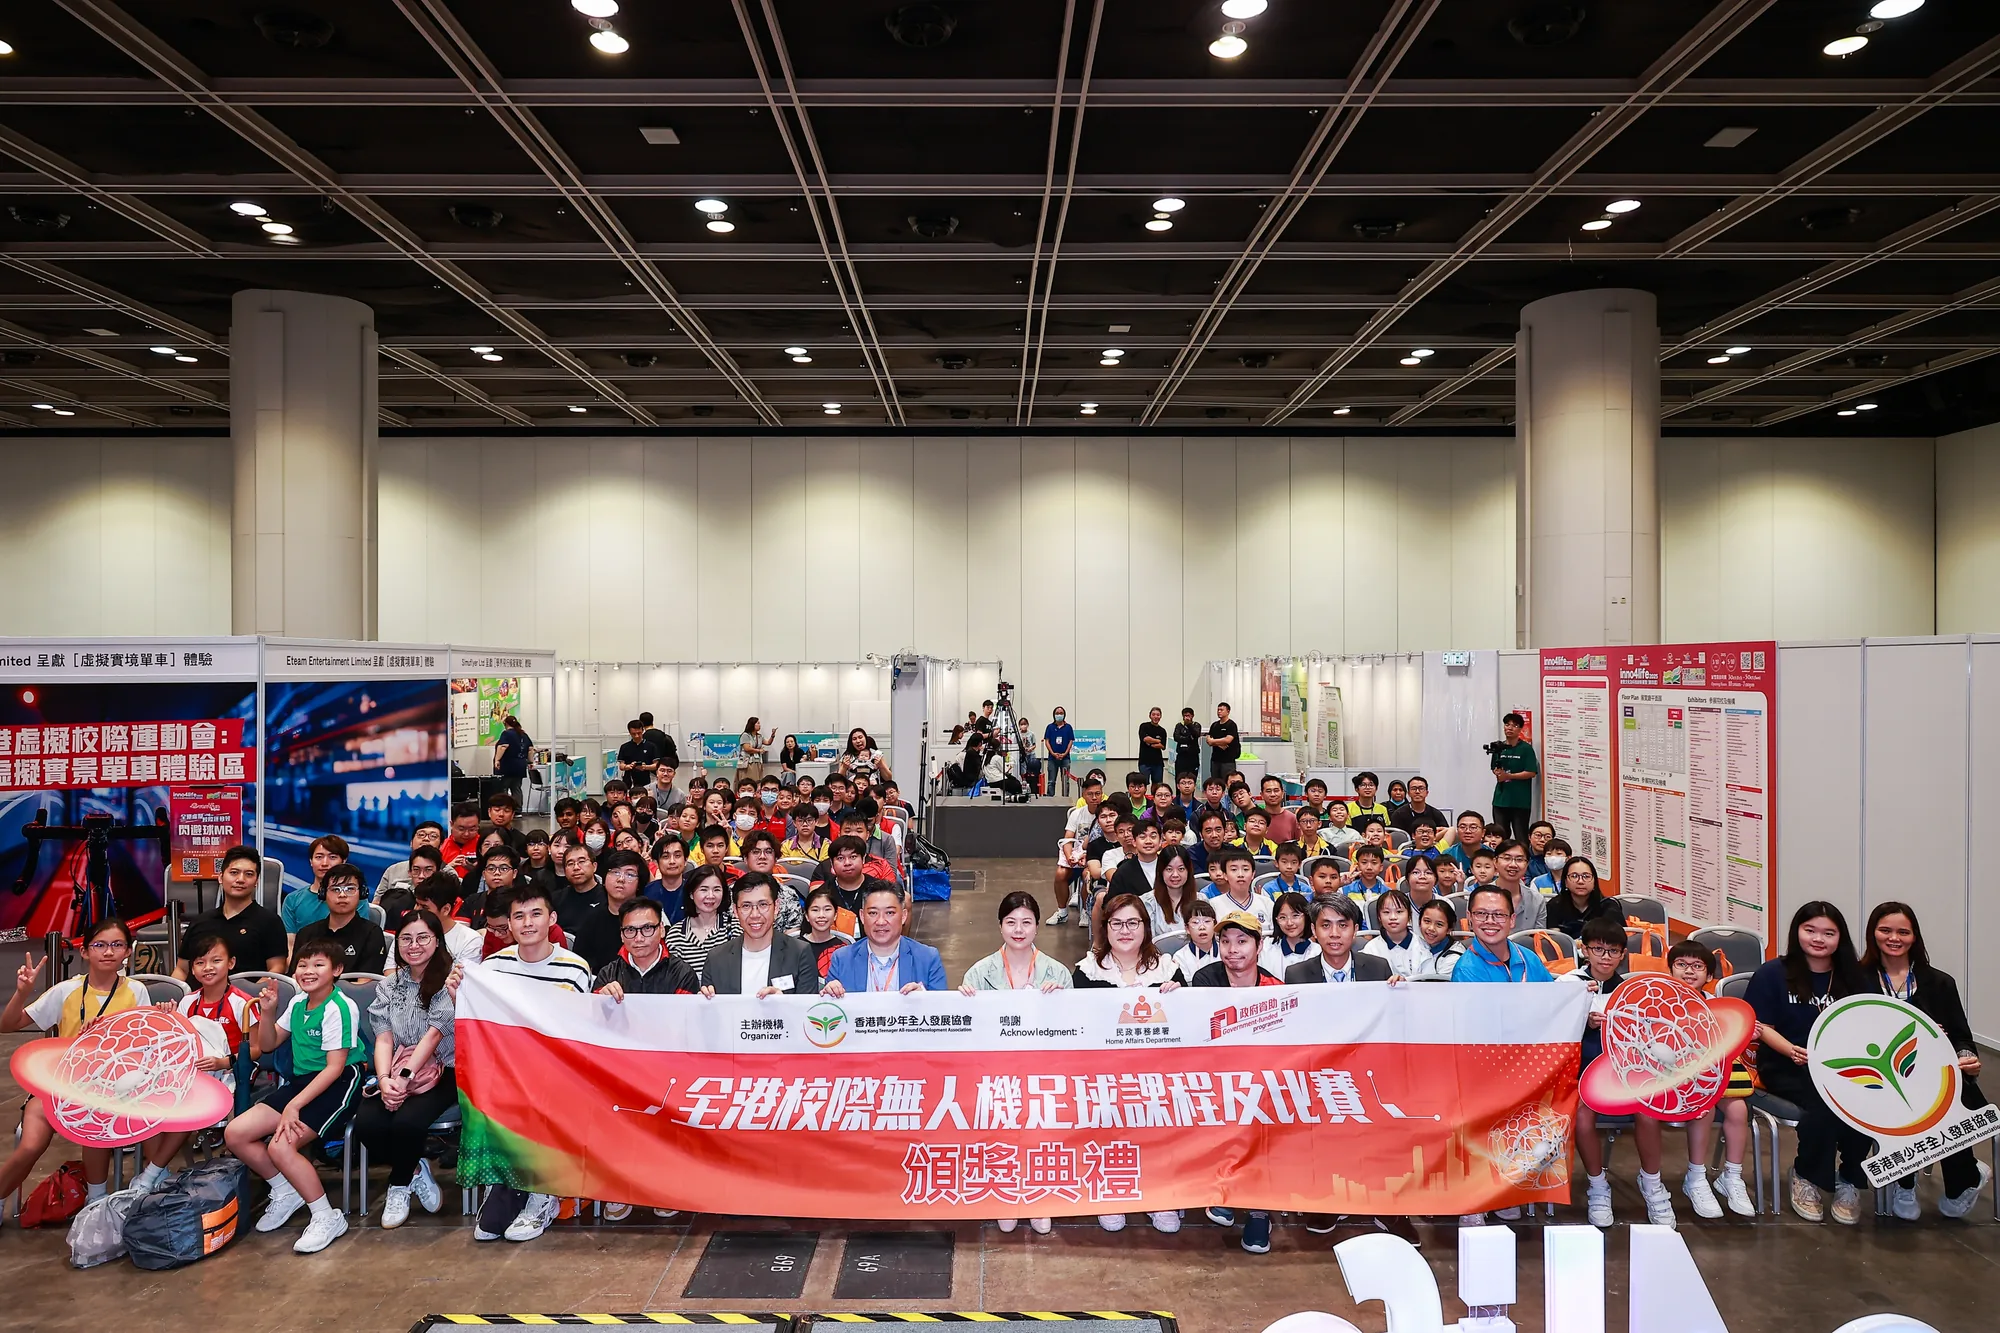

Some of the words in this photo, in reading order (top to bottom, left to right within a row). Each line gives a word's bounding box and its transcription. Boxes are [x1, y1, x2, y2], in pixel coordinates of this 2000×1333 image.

[286, 656, 307, 666] Eteam
[309, 656, 349, 666] Entertainment
[351, 656, 371, 666] Limited
[740, 1019, 784, 1030] 主辦機構
[854, 1015, 973, 1028] 香港青少年全人發展協會
[1000, 1015, 1021, 1026] 鳴謝
[1222, 1011, 1279, 1035] Government-funded
[1252, 1018, 1284, 1033] programme
[1116, 1027, 1170, 1036] 民政事務總署
[1146, 1036, 1181, 1044] Department
[671, 1068, 1374, 1131] 全港校際無人機足球課程及比賽
[1866, 1109, 1999, 1177] 香港青少年全人發展協會
[1875, 1176, 1889, 1184] Hong
[1888, 1169, 1902, 1179] Kong
[1902, 1159, 1923, 1173] Teenager
[1923, 1150, 1945, 1163] All-round
[1944, 1136, 1976, 1153] Development
[900, 1140, 1142, 1206] 頒獎典禮
[770, 1255, 796, 1272] 69B
[857, 1254, 880, 1272] 69A
